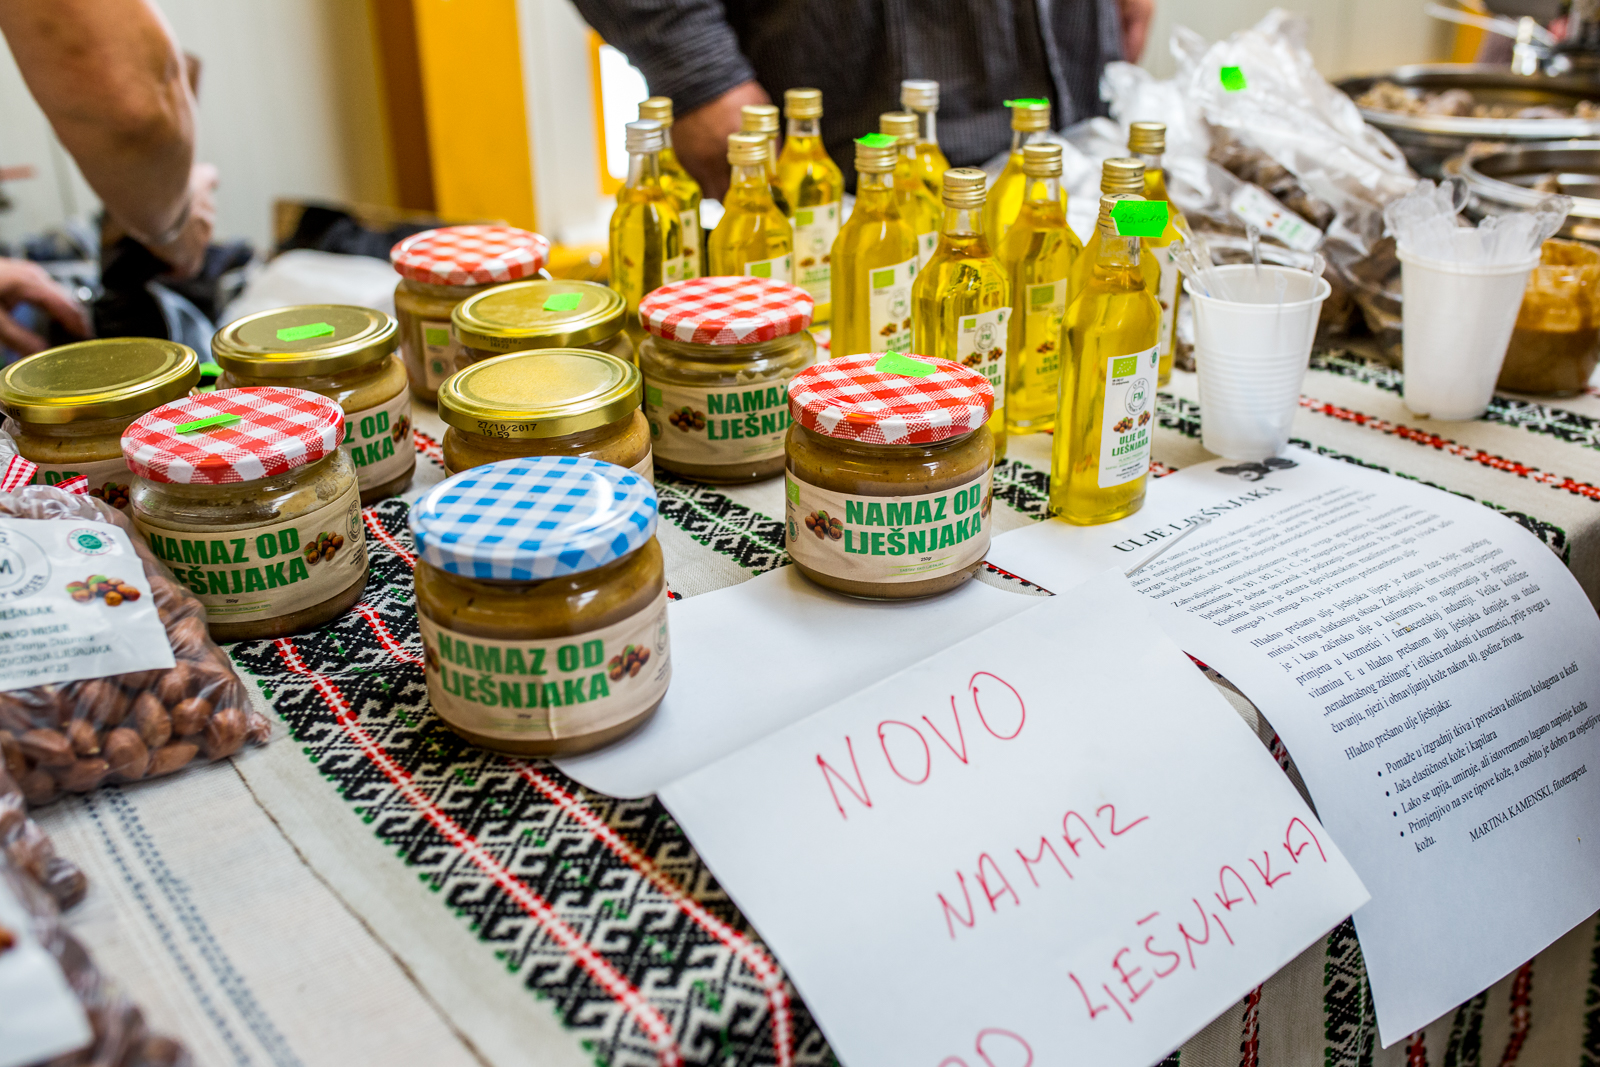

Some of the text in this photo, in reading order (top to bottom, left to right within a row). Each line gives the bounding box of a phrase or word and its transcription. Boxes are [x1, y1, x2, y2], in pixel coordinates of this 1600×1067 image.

[1133, 391, 1144, 402] FM
[360, 410, 390, 439] OD
[477, 420, 537, 433] 27/10/2017
[481, 428, 510, 439] 19:59
[1111, 436, 1149, 457] LJEŠNJAKA
[1119, 428, 1146, 445] ULJE OD
[845, 483, 981, 527] NAMAZ OD
[150, 532, 249, 565] NAMAZ
[256, 527, 300, 560] OD
[844, 510, 982, 556] LJEŠNJAKA
[1112, 527, 1172, 553] ULJE
[1213, 611, 1250, 627] kiselina
[1249, 599, 1274, 612] slično
[1250, 631, 1283, 648] Hladno
[1284, 617, 1316, 635] prešano
[1317, 608, 1334, 618] ulje
[1332, 593, 1369, 611] lješnjaka
[1366, 583, 1392, 595] lijepe
[1267, 643, 1295, 658] mirisa
[1297, 631, 1323, 644] finog
[1320, 614, 1361, 634] slatkastog
[1279, 662, 1292, 673] je
[1292, 656, 1301, 664] i
[1299, 650, 1319, 661] kao
[1320, 633, 1355, 652] začinsko
[1356, 624, 1373, 635] ulje
[1380, 601, 1426, 623] kulinarstvu,
[1426, 595, 1438, 603] no
[1295, 663, 1333, 686] primjena
[1342, 637, 1383, 661] kozmetici
[1391, 609, 1443, 638] farmaceutskoj
[1441, 594, 1476, 615] industriji.
[1475, 584, 1501, 597] Velike
[1417, 651, 1444, 668] eliksira
[1442, 634, 1473, 656] mladosti
[1475, 616, 1512, 639] kozmetici,
[1510, 609, 1527, 625] prije
[1526, 601, 1545, 615] svega
[437, 631, 547, 676] NAMAZ
[557, 638, 605, 673] OD
[1308, 678, 1345, 698] vitamina
[1344, 670, 1355, 681] E
[1365, 654, 1394, 671] hladno
[1396, 636, 1431, 660] prešanom
[1432, 627, 1449, 640] ulju
[1448, 613, 1481, 633] lješnjaka
[1482, 598, 1510, 616] donijele
[1511, 593, 1521, 602] su
[1521, 583, 1540, 597] titulu
[439, 671, 611, 709] LJEŠNJAKA
[1330, 712, 1366, 733] čuvanju,
[1364, 699, 1385, 717] njezi
[1388, 678, 1431, 705] obnavljanju
[1427, 670, 1448, 684] kože
[1446, 659, 1469, 675] nakon
[1467, 652, 1481, 663] 40.
[1479, 642, 1503, 661] godine
[1500, 632, 1524, 648] života.
[1344, 699, 1452, 760] Hladno prešano ulje lješnjaka:
[1385, 752, 1416, 774] Pomaže
[1420, 729, 1454, 754] izgradnji
[1453, 722, 1472, 737] tkiva
[1475, 703, 1507, 728] povećava
[1504, 689, 1533, 709] količinu
[1530, 674, 1560, 695] kolagena
[1563, 661, 1579, 677] koži
[815, 671, 1026, 821] NOVO
[1394, 779, 1412, 794] Jača
[1412, 757, 1449, 784] elastičnost
[1447, 748, 1466, 763] kože
[1468, 731, 1498, 751] kapilara
[1401, 797, 1422, 814] Lako
[1430, 780, 1452, 798] upija,
[1451, 763, 1481, 785] umiruje,
[1480, 754, 1490, 769] ali
[1489, 735, 1530, 763] istovremeno
[1528, 723, 1551, 740] lagano
[1550, 709, 1573, 728] napinje
[1571, 701, 1588, 715] kožu
[1408, 804, 1451, 834] Primjenjivo
[1451, 798, 1461, 809] na
[1461, 790, 1474, 803] sve
[1473, 777, 1495, 796] tipove
[1493, 768, 1514, 783] kože,
[1519, 750, 1543, 769] osobito
[1550, 735, 1568, 751] dobro
[1469, 764, 1587, 842] MARTINA KAMENSKI, fitoterapeut
[1414, 836, 1437, 853] kožu.
[936, 803, 1149, 940] NAMAZ
